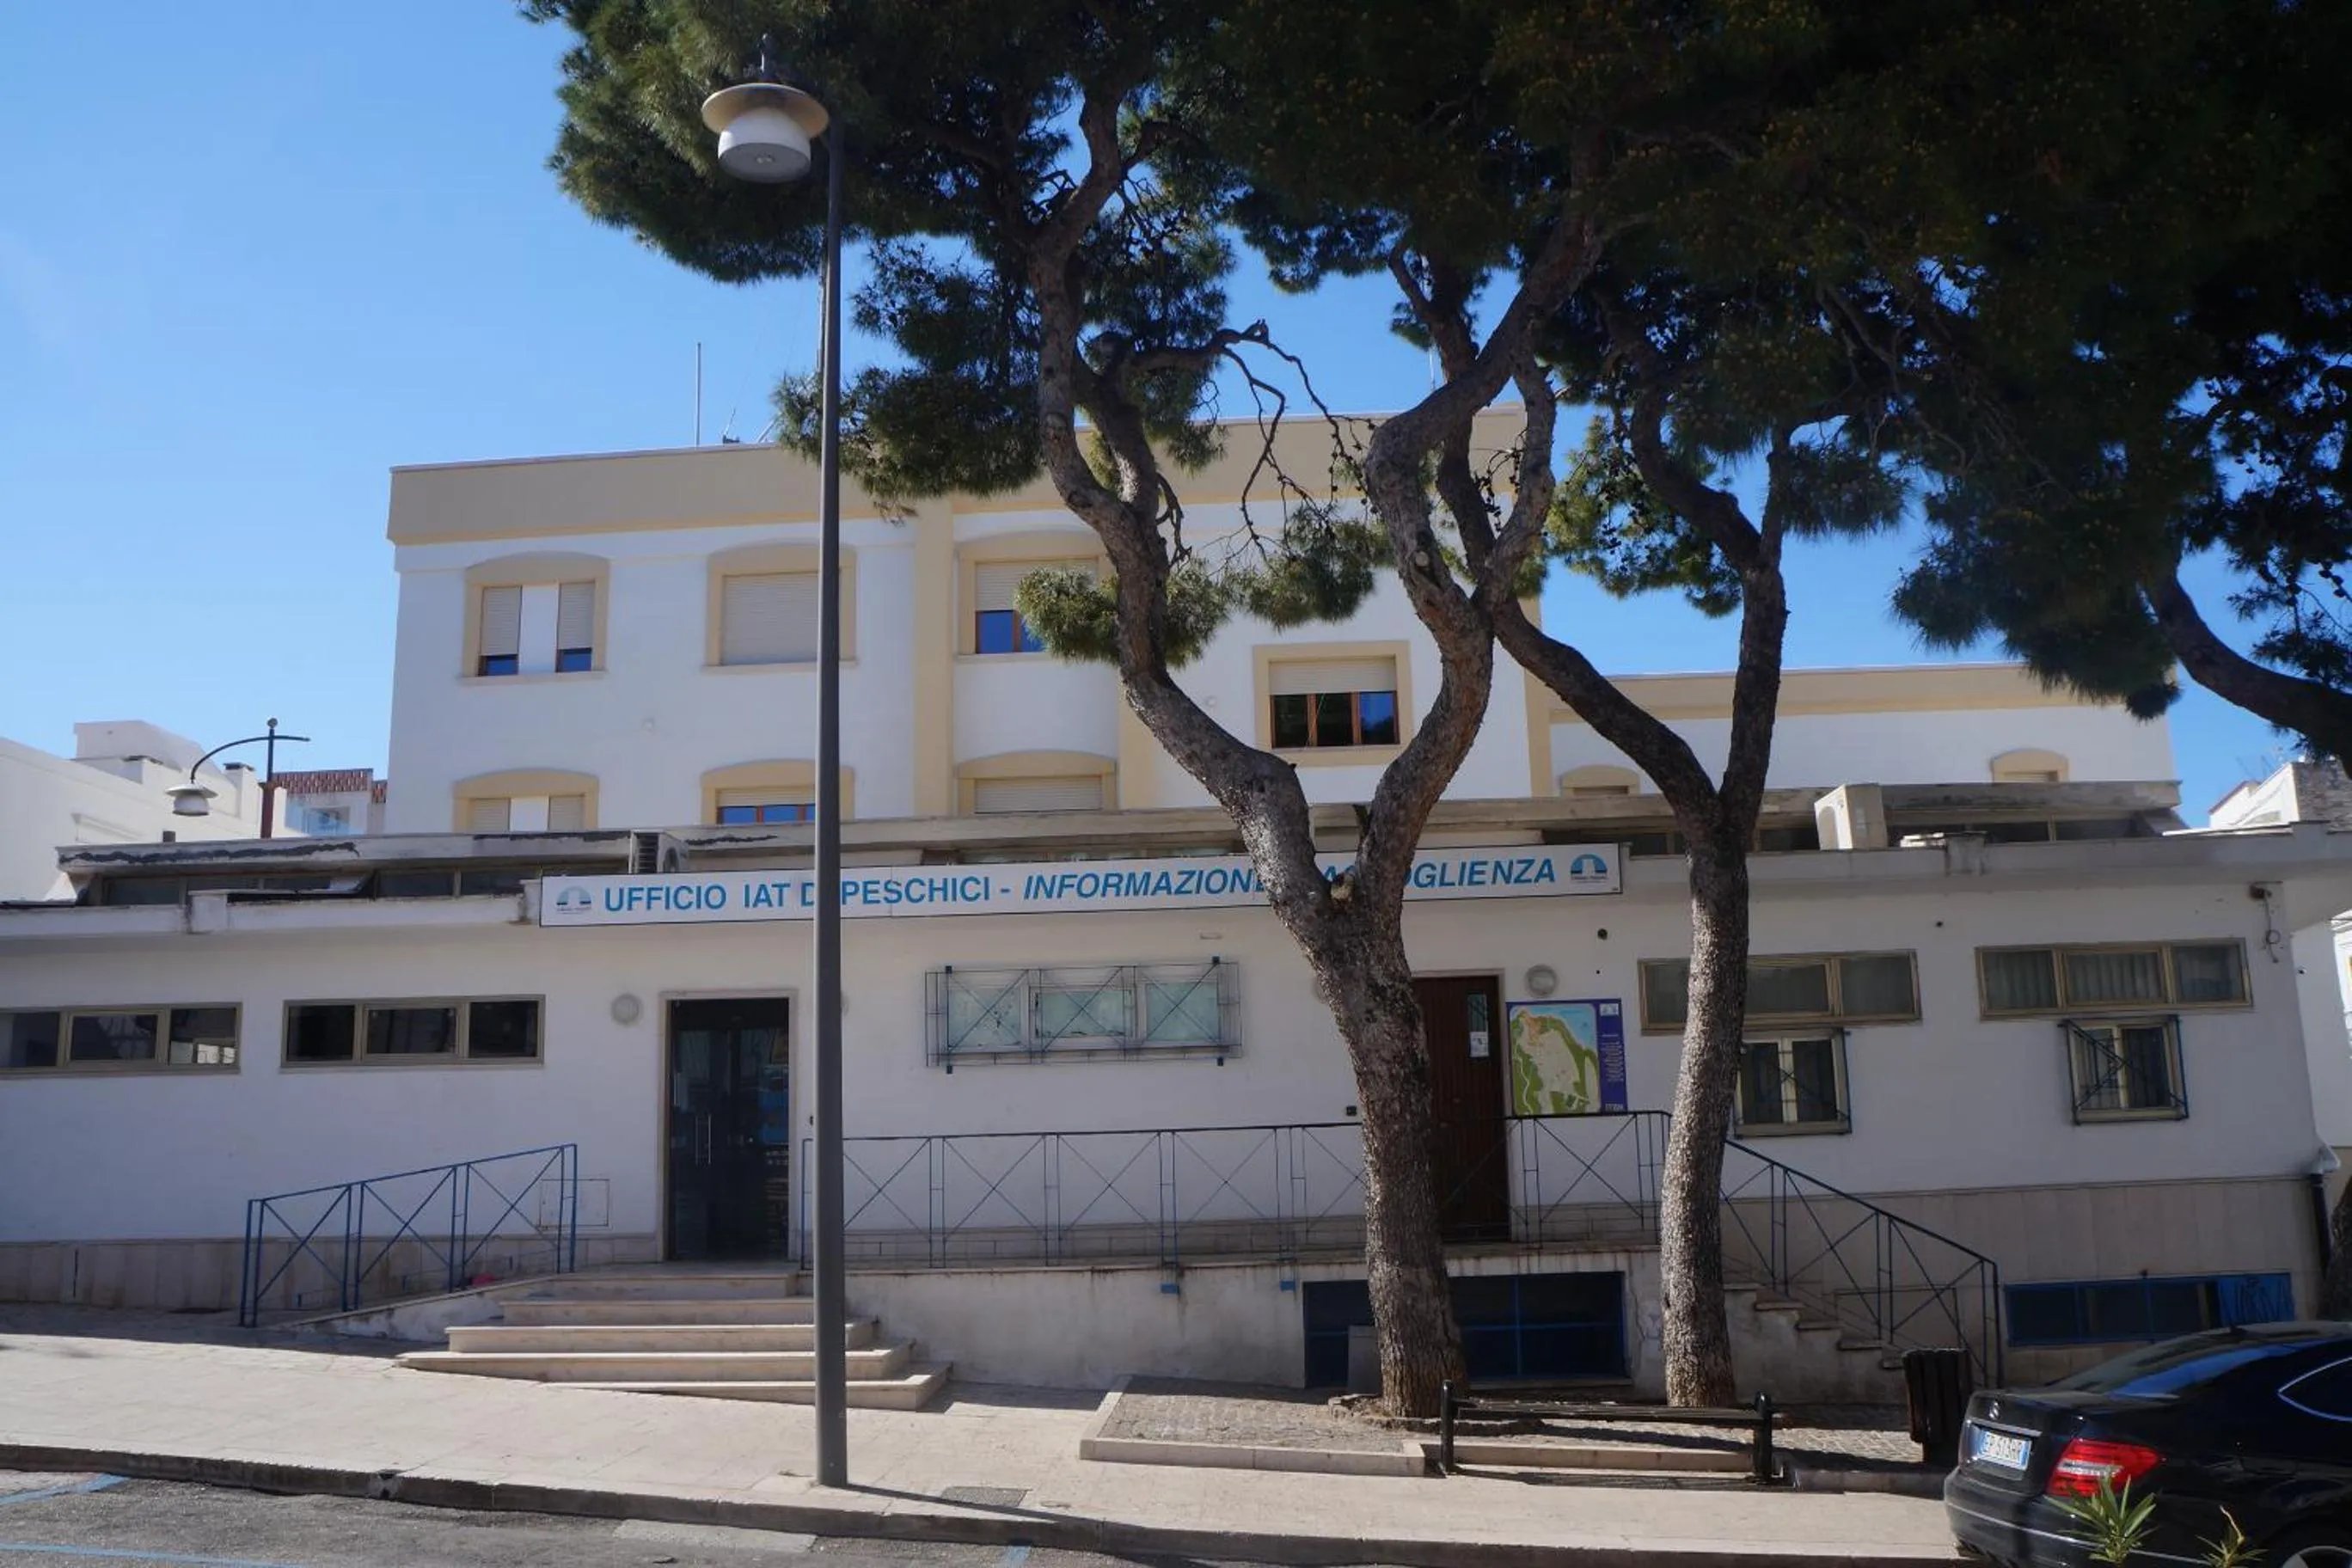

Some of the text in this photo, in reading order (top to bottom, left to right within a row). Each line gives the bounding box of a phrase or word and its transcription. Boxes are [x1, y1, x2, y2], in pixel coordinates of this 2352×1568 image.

[604, 884, 727, 911] UFFICIO
[744, 882, 792, 909] IAT
[841, 876, 990, 905] PESCHICI
